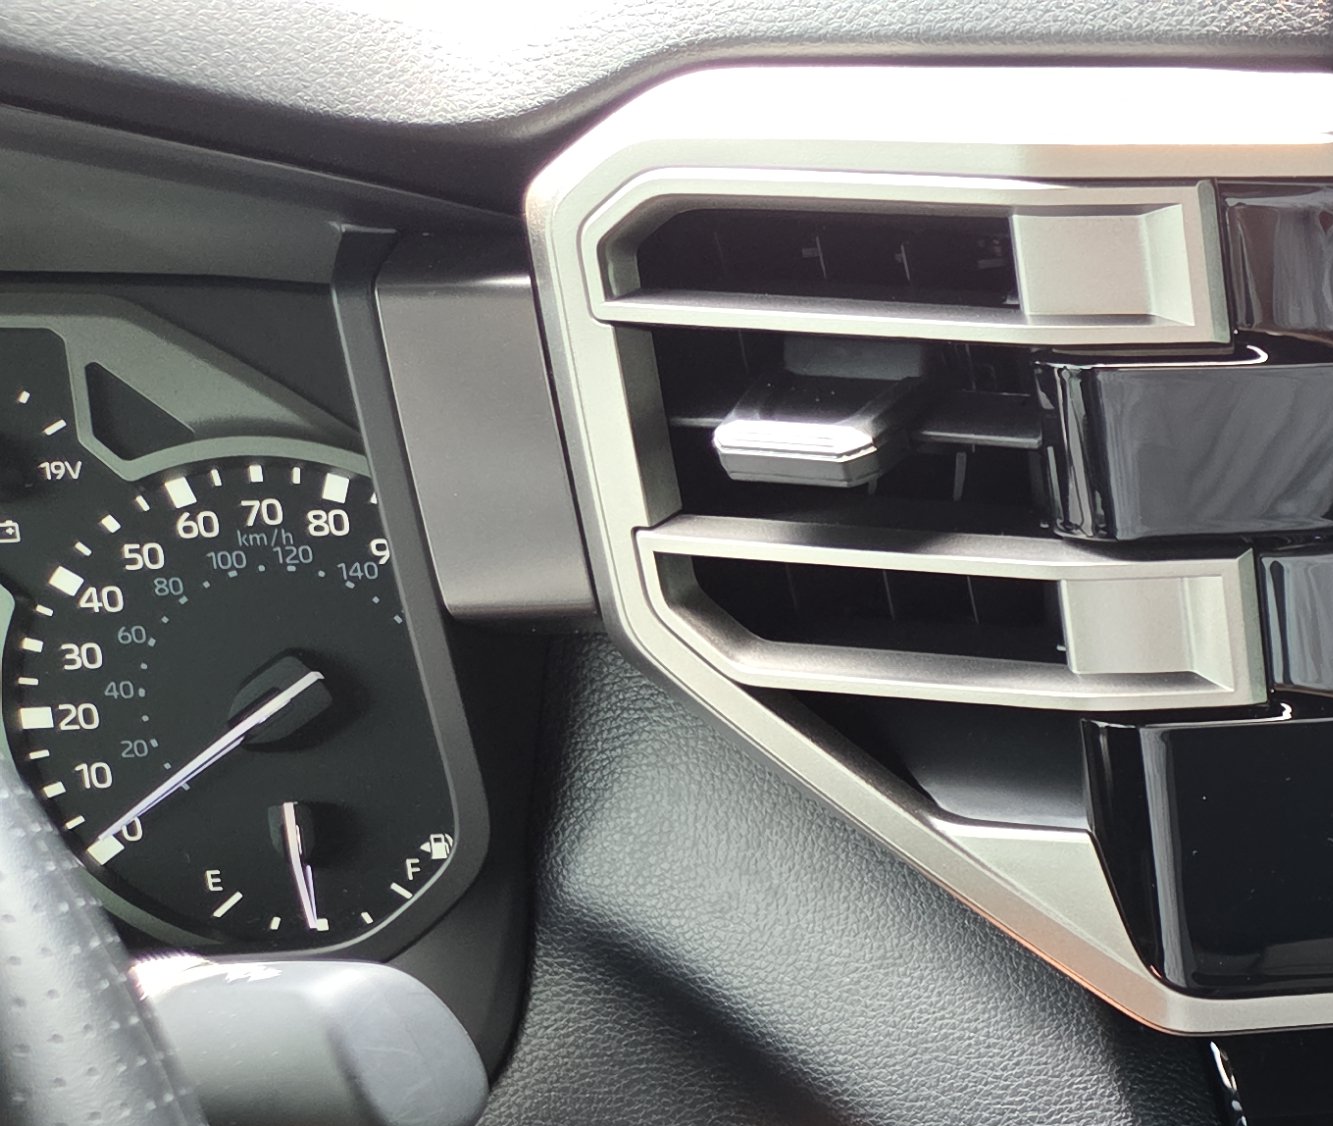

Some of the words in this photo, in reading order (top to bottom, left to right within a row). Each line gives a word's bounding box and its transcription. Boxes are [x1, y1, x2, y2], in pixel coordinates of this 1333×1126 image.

[38, 460, 83, 481] 19V
[177, 510, 220, 540] 60
[240, 498, 283, 529] 70
[308, 509, 350, 538] 80
[236, 527, 295, 547] km/h
[122, 542, 165, 571] 50
[206, 550, 247, 570] 100
[273, 546, 314, 565] 120
[370, 538, 390, 566] 9
[336, 561, 380, 582] 140
[153, 576, 184, 596] 80
[78, 585, 124, 613] 40
[117, 625, 147, 645] 60
[60, 642, 103, 671] 30
[104, 680, 135, 700] 40
[57, 703, 100, 730] 20
[120, 739, 148, 759] 20
[74, 762, 112, 790] 10
[205, 869, 222, 893] E
[405, 857, 421, 881] F
